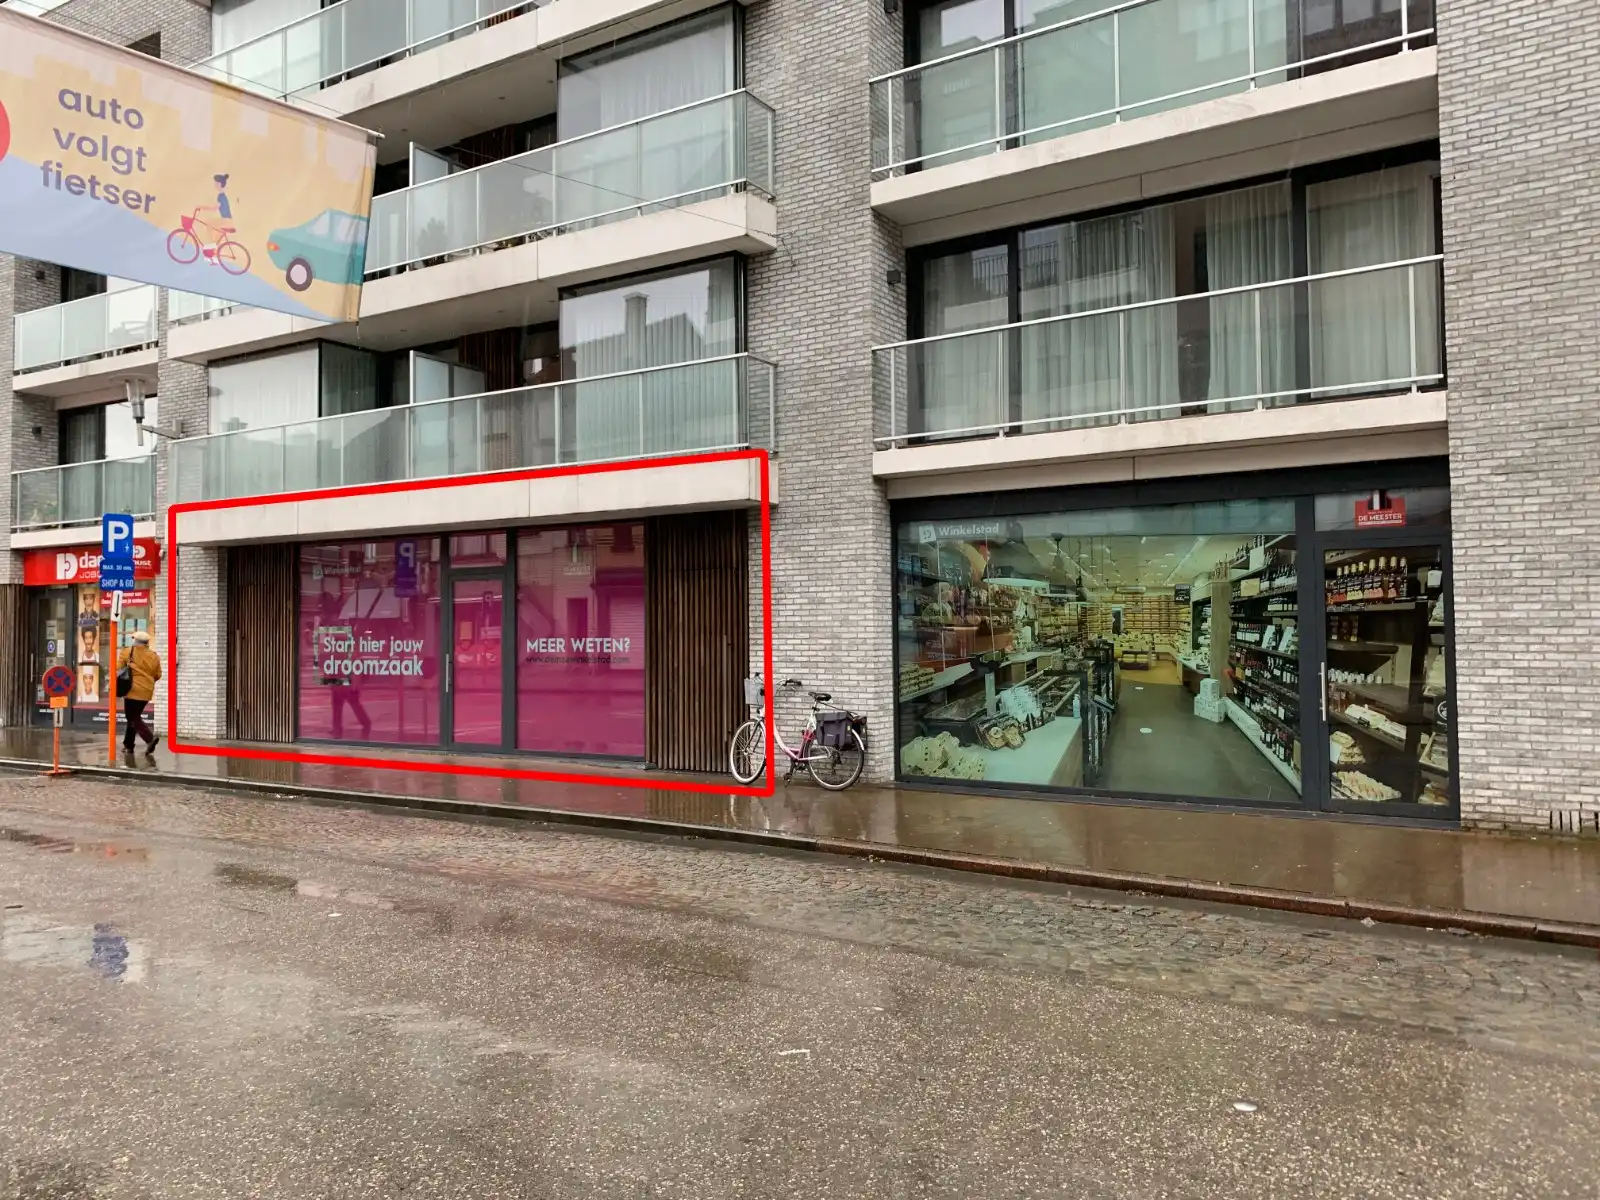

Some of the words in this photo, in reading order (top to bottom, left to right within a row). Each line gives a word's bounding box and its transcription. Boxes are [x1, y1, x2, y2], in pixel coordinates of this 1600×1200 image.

[58, 88, 145, 131] auto
[52, 127, 148, 176] volgt
[40, 159, 156, 214] fietser
[1369, 513, 1402, 521] MEESTER
[108, 521, 129, 552] P
[939, 522, 999, 536] Winkelstad
[101, 578, 118, 588] SHOP
[125, 578, 134, 588] GO
[323, 636, 356, 653] Start
[359, 635, 386, 653] hier
[389, 635, 424, 657] jouw
[526, 638, 565, 652] MEER
[570, 637, 631, 653] WETEN?
[323, 654, 424, 676] droomzaak
